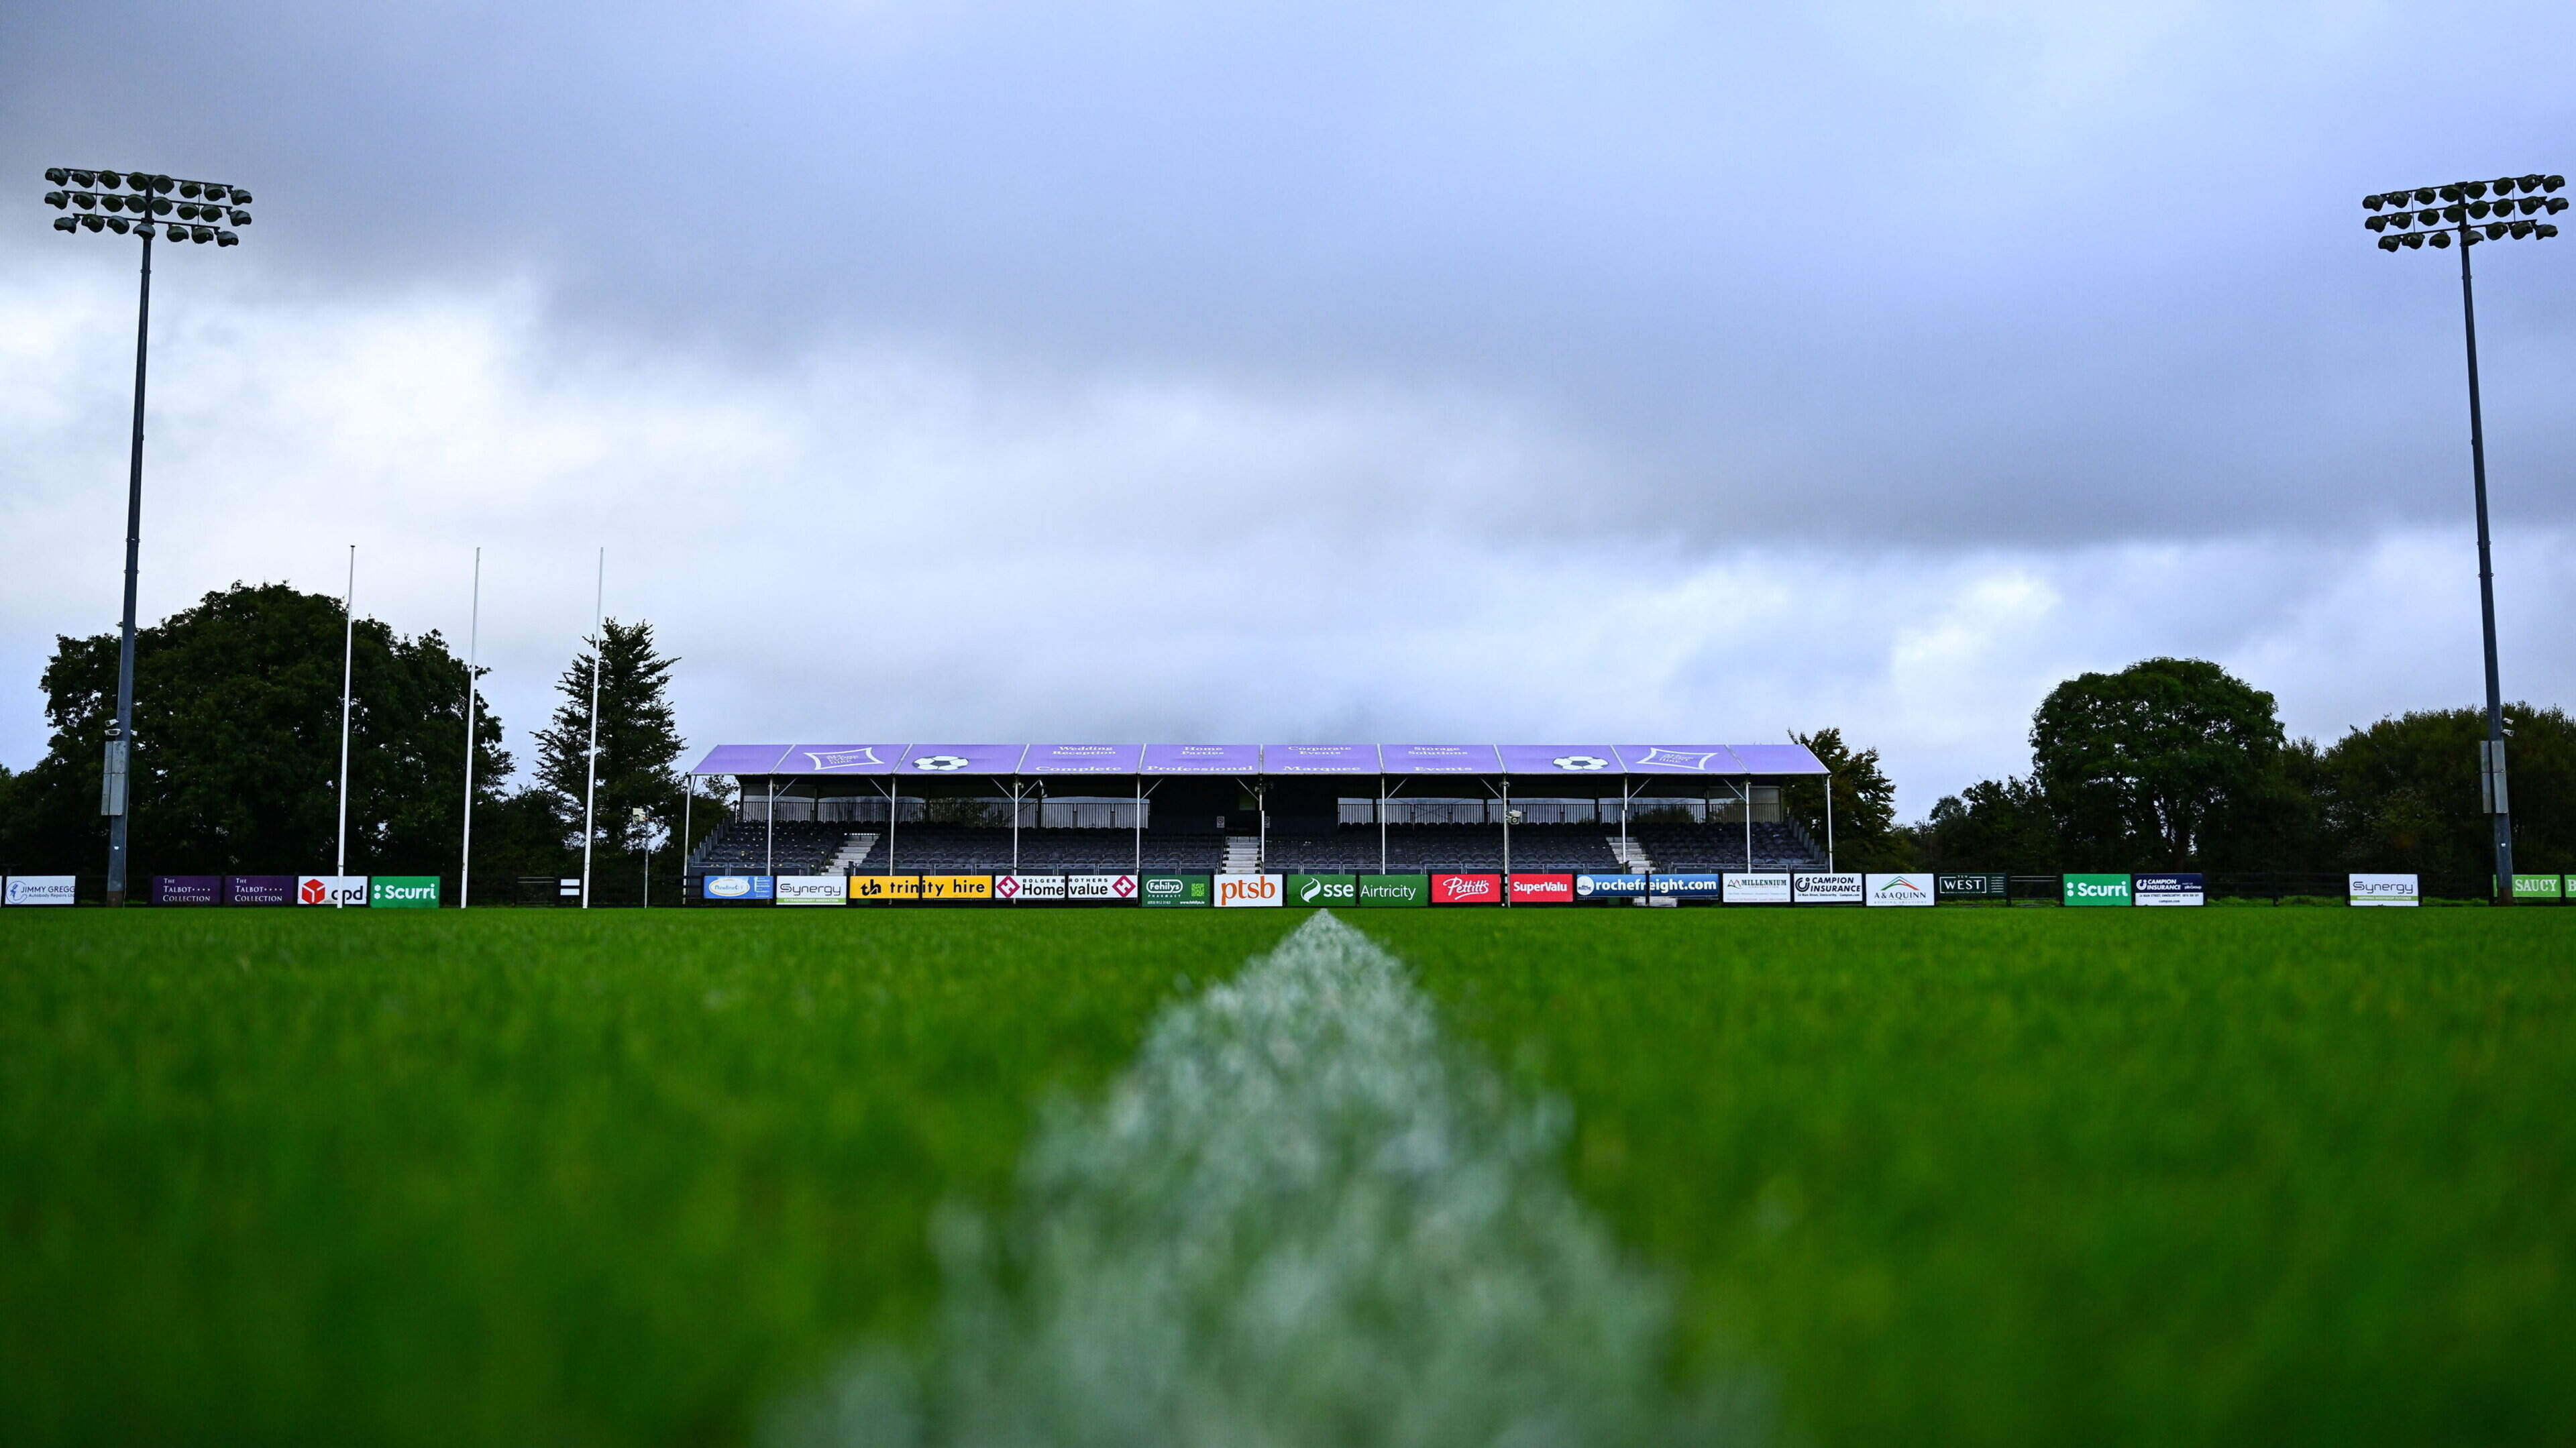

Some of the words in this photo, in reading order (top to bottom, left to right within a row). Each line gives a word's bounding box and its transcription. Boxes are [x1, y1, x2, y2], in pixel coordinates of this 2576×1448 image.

[384, 883, 436, 899] Scurri
[780, 883, 841, 896] Synergy
[890, 880, 945, 896] trinity
[953, 879, 985, 893] hire
[1150, 881, 1179, 892] Fehilys
[1221, 875, 1275, 905] ptsb
[1323, 883, 1354, 897] sse
[1360, 885, 1416, 900] Airtricity
[1513, 881, 1568, 894] SuperValu
[1595, 878, 1717, 893] rochefreight.com
[1943, 879, 1982, 890] WEST
[2078, 881, 2129, 897] Scurri
[2353, 881, 2414, 894] Synergy
[2515, 879, 2557, 891] SAUCY
